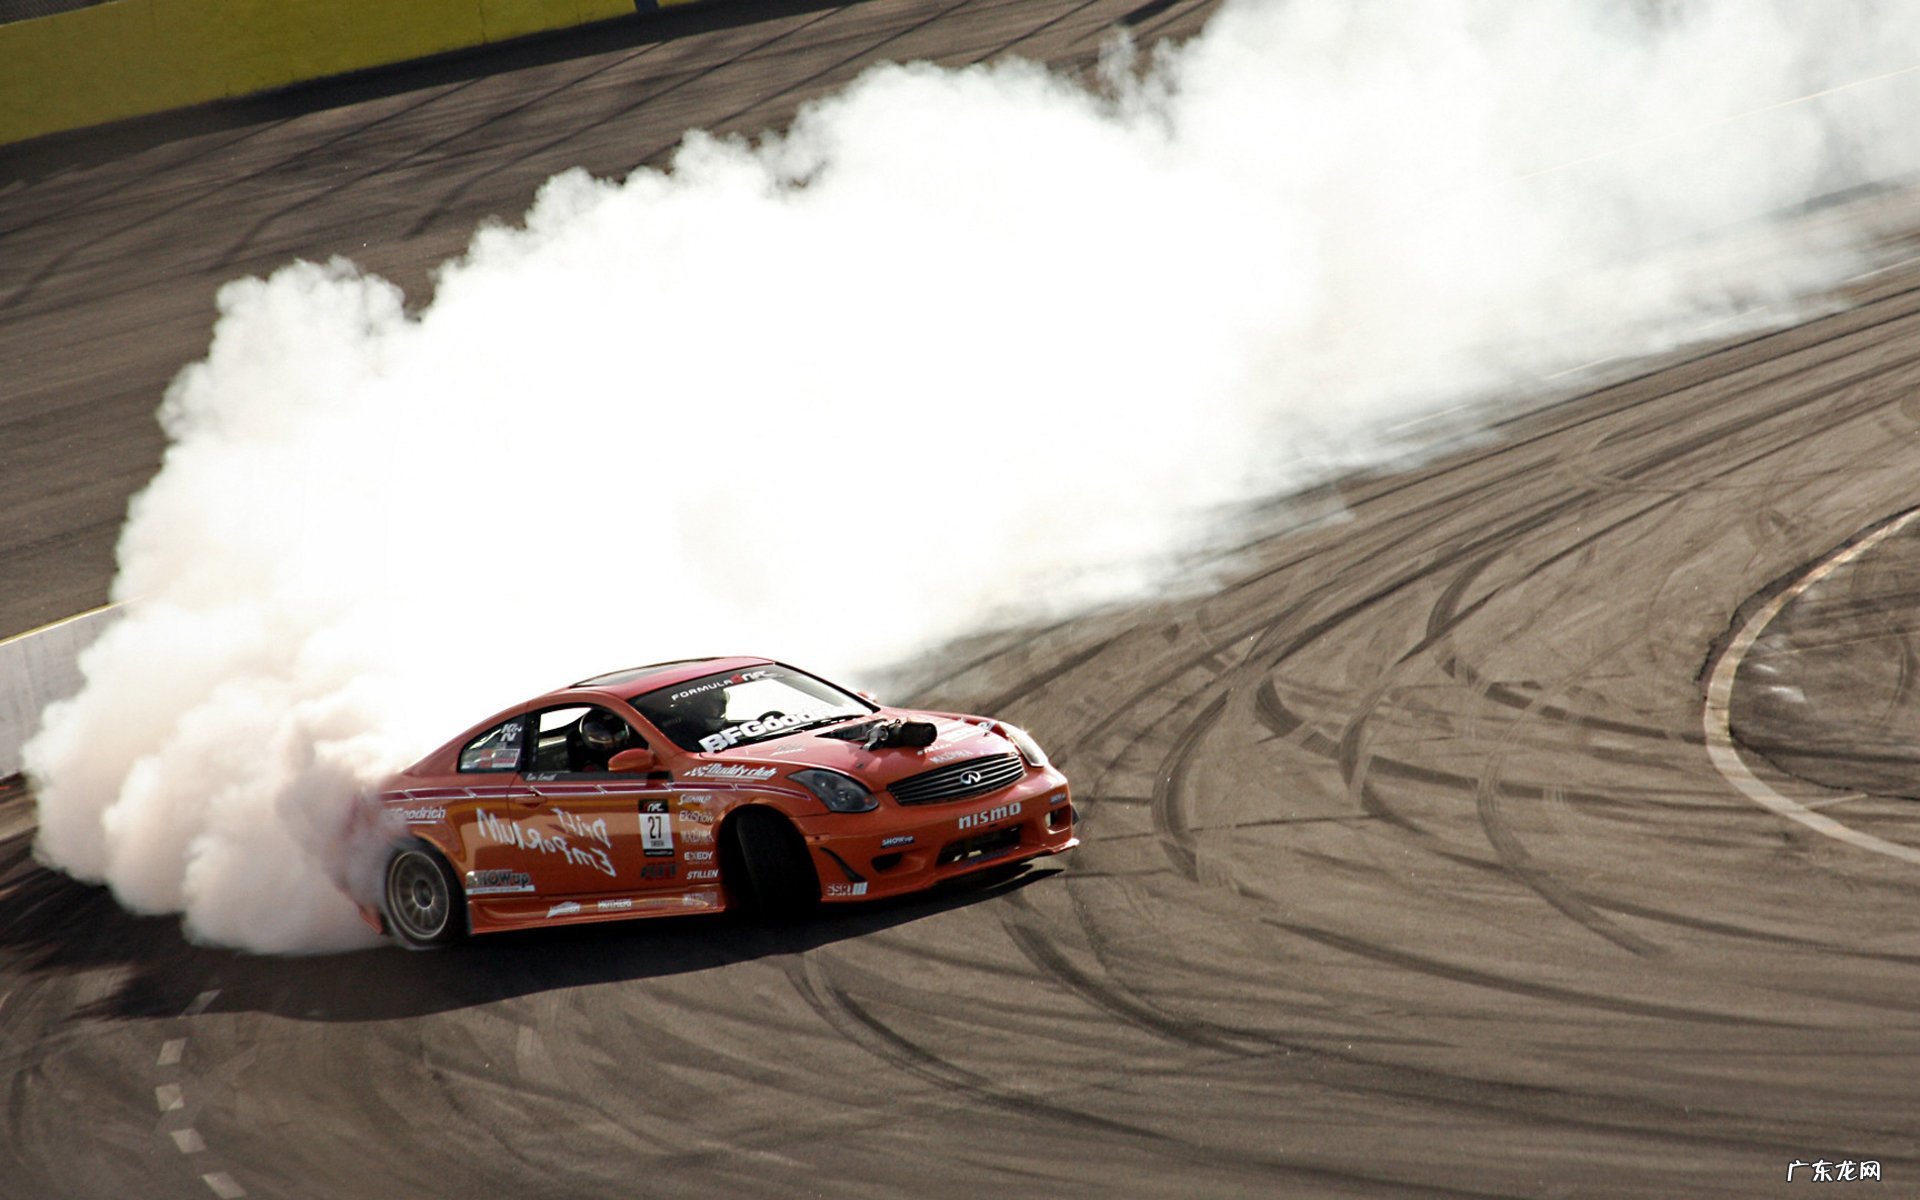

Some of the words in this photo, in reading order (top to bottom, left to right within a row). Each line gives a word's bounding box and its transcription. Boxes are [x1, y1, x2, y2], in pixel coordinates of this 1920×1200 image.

[671, 679, 733, 701] FORMULA
[698, 709, 832, 753] BFGood
[647, 816, 662, 840] 27
[687, 869, 719, 880] STILLEN
